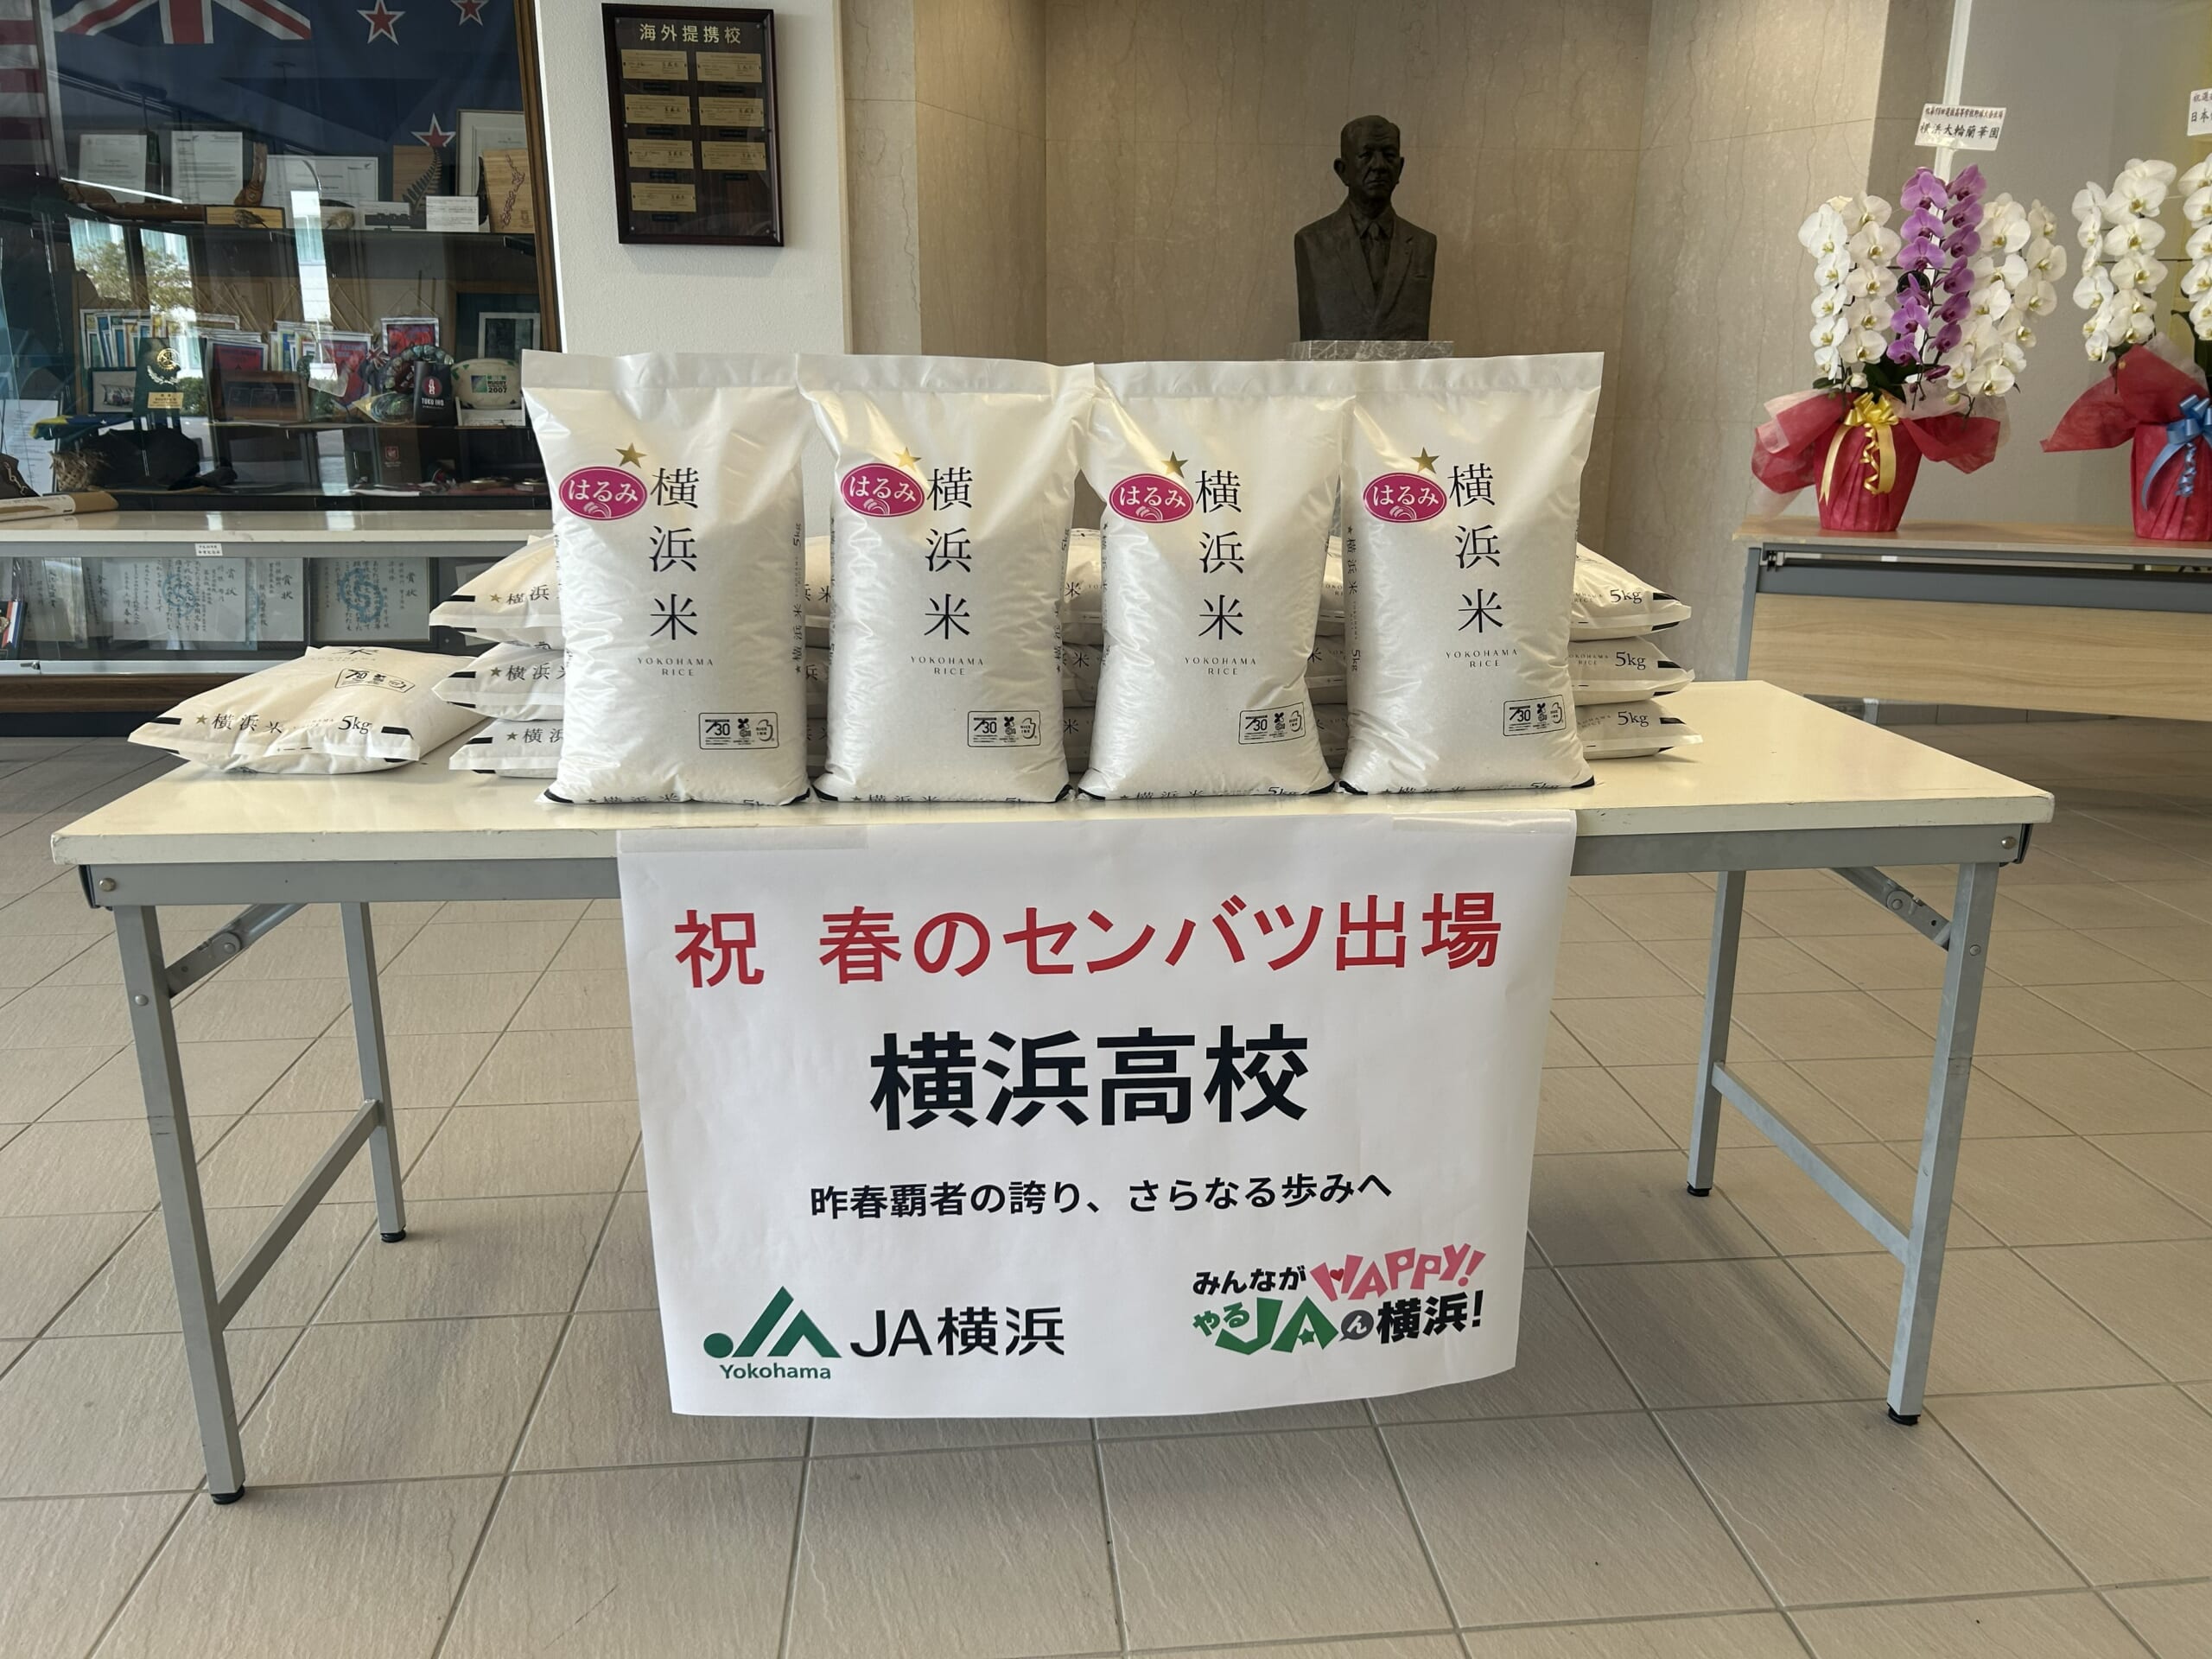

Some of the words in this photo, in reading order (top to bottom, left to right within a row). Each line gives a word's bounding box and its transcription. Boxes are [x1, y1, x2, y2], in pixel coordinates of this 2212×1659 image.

[639, 23, 741, 44] 海外提携校
[2191, 108, 2212, 123] 日本
[568, 479, 639, 504] はるみ
[849, 476, 916, 504] はるみ
[1120, 486, 1186, 508] はるみ
[1373, 486, 1440, 507] はるみ
[648, 467, 700, 641] 横浜米
[924, 466, 973, 640] 横浜米
[1196, 470, 1245, 640] 横浜米
[1447, 463, 1503, 634] 横浜米
[281, 574, 294, 600] 賞状
[406, 571, 418, 597] 賞状
[506, 584, 560, 605] 横浜
[1610, 589, 1642, 604] 5kg
[637, 657, 714, 666] YOKOHAMA
[911, 656, 984, 666] YOKOHAMA
[1185, 656, 1257, 665] YOKOHAMA
[1446, 647, 1518, 659] YOKOHAMA
[1615, 652, 1646, 671] 5kg
[662, 668, 696, 677] RICE
[934, 667, 966, 677] RICE
[1208, 668, 1239, 677] RICE
[1469, 659, 1500, 669] RICE
[339, 715, 373, 734] 5kg
[1618, 711, 1649, 728] 5kg
[675, 910, 765, 988] 祝
[819, 892, 1501, 983] 春のセンバツ出場
[870, 1023, 1308, 1131] 横浜高校
[811, 1173, 1391, 1219] 昨春覇者の誇り、さらなる歩みへ
[1192, 1265, 1308, 1295] みんなが
[850, 1306, 1065, 1357] JA横浜
[721, 1363, 832, 1380] Yokohama
